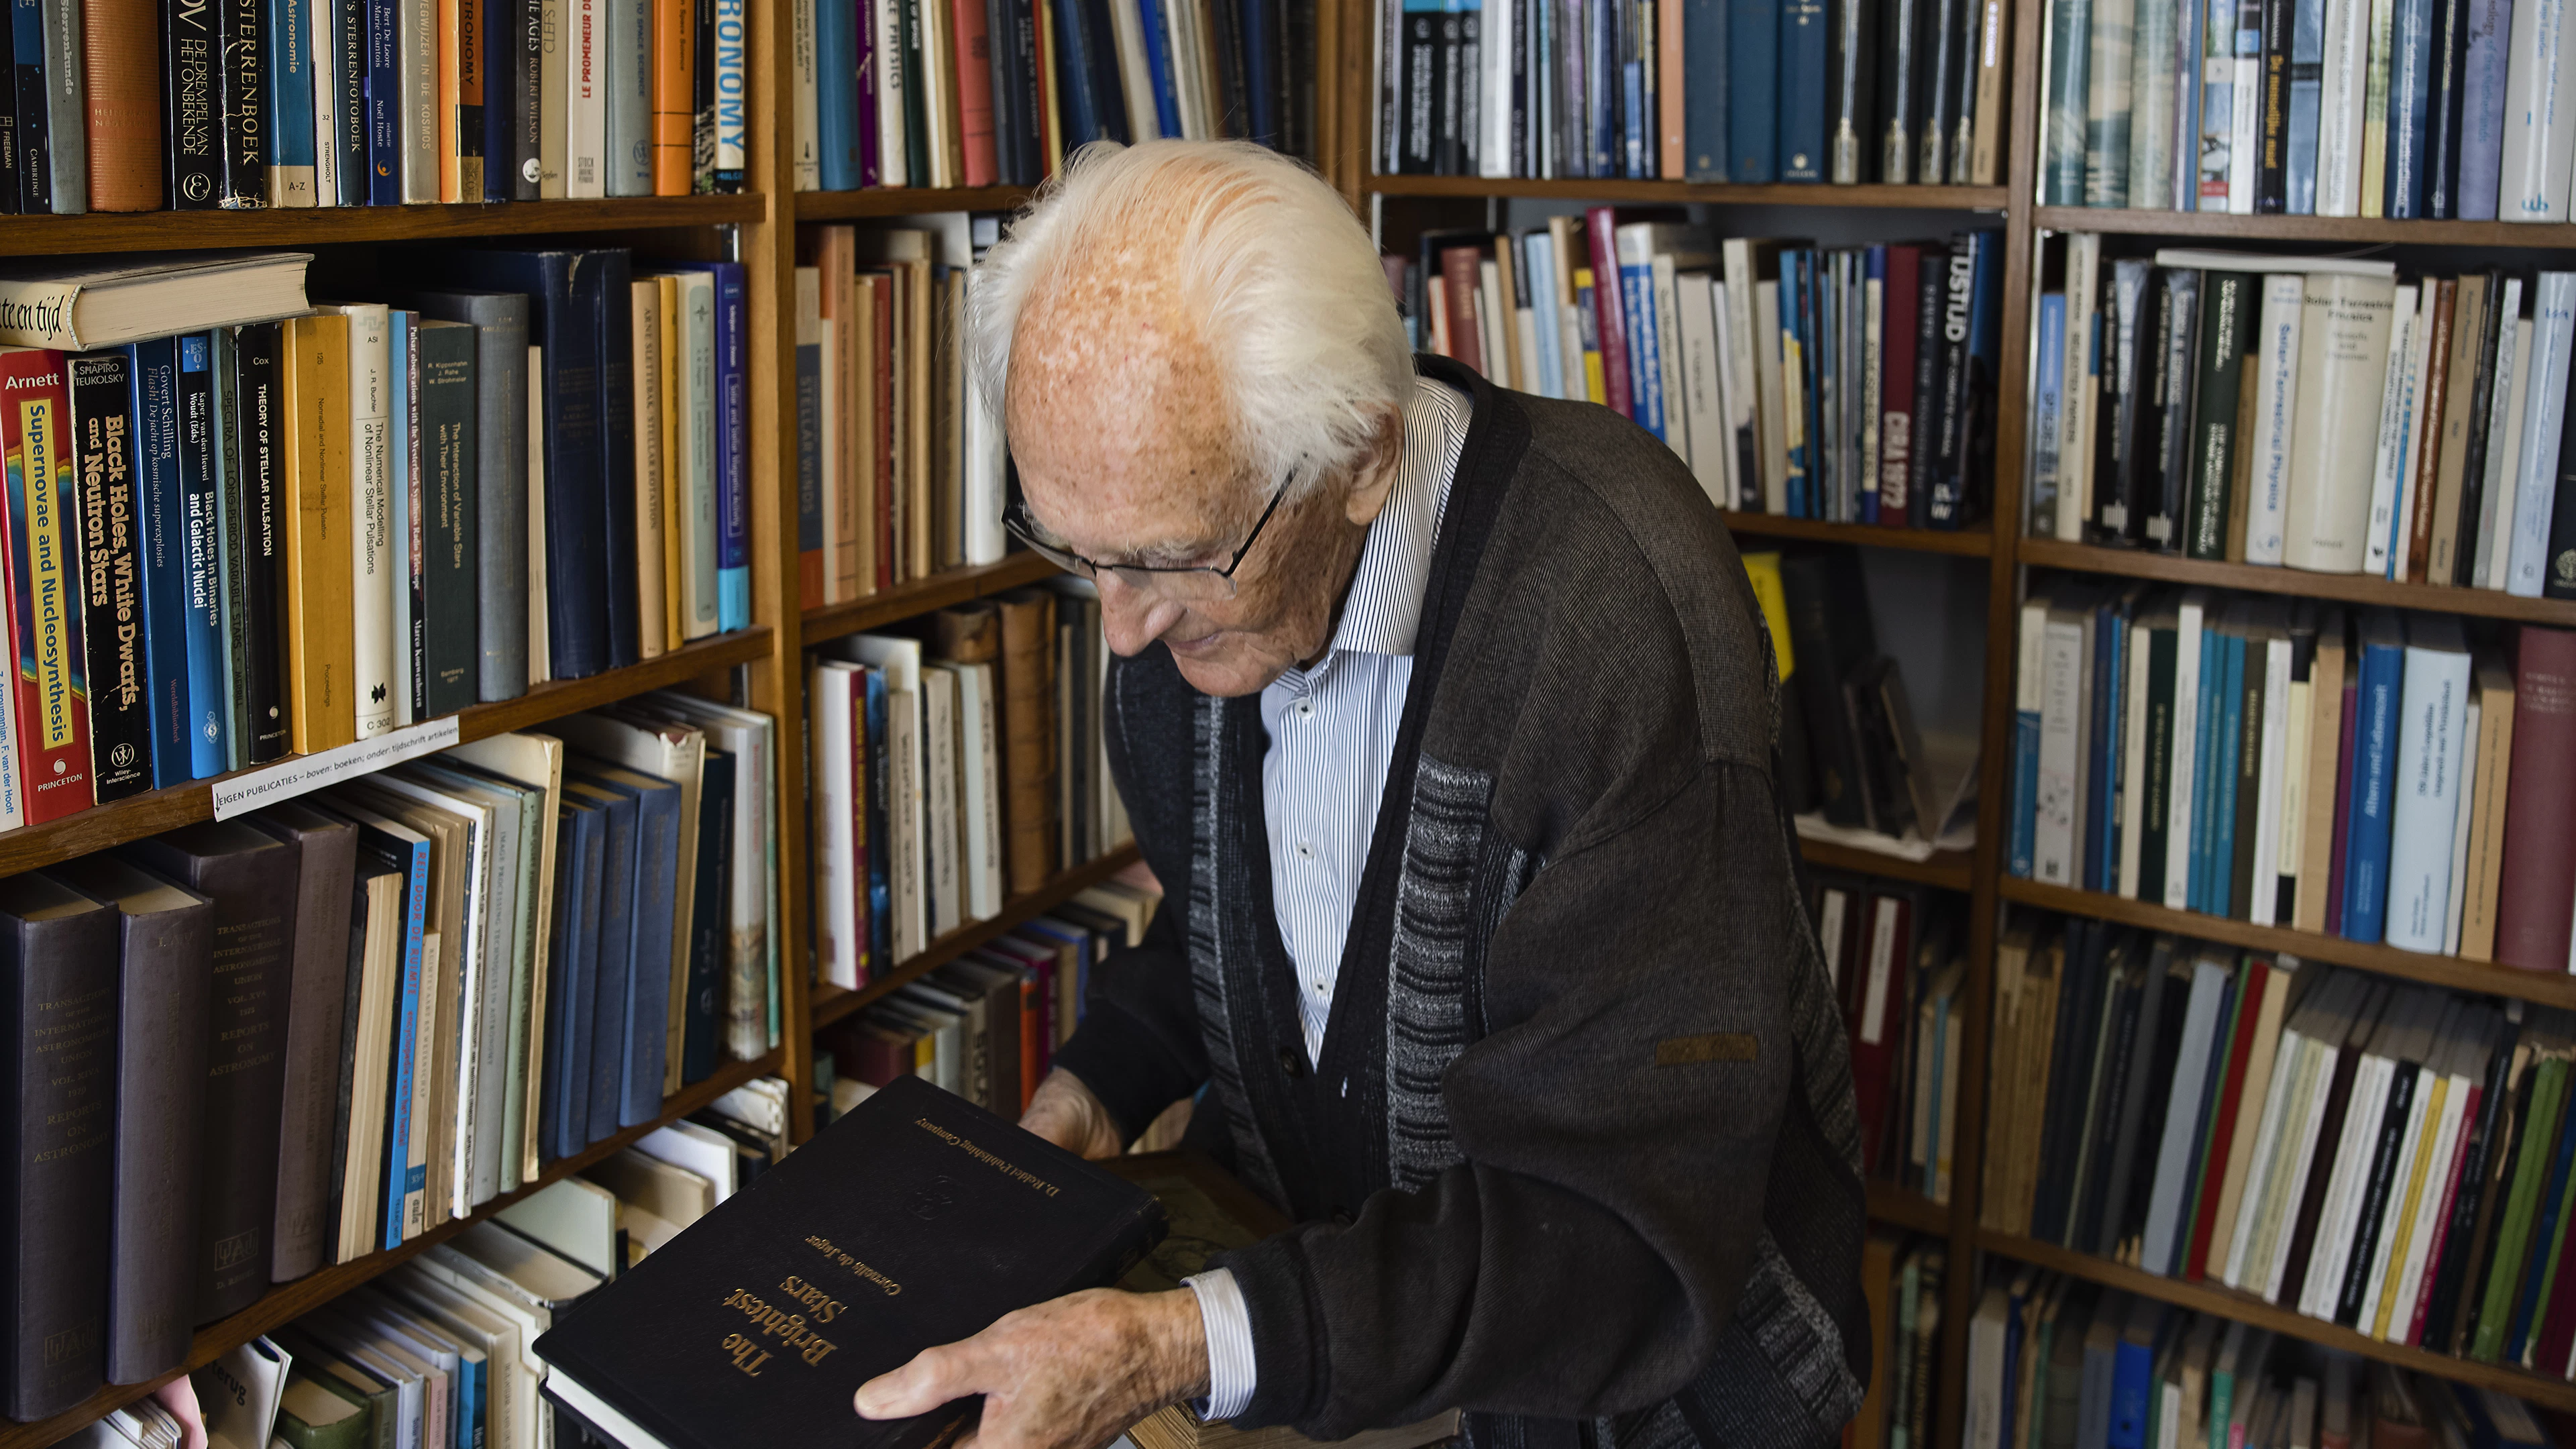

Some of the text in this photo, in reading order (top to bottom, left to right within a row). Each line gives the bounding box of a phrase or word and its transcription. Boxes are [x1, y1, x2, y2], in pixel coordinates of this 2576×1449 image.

[543, 9, 556, 53] CLEFS
[528, 16, 540, 143] AGES ROBERT WILSON
[582, 14, 592, 99] LE PROMENEUR
[888, 25, 901, 89] PHYSICS
[180, 38, 196, 155] HET ONBEKENDE
[195, 40, 209, 156] DE DREMPEL VAN
[347, 16, 361, 153] STERRENFOTOBOEK
[421, 64, 431, 150] IN DE KOSMOS
[3, 131, 11, 168] FREEMAN
[30, 148, 39, 198] CAMBRIDGE
[288, 182, 305, 191] A-Z
[17, 294, 65, 341] en tijd
[5, 373, 59, 390] Arnett
[75, 374, 125, 386] TEUKOLSKY
[79, 363, 119, 375] SHAPIRO
[253, 357, 269, 365] Cox
[160, 365, 174, 460] Govert Schilling
[189, 392, 199, 443] Woudt (Eds.)
[198, 392, 206, 415] Kaper
[410, 326, 420, 487] Pulsar observations Westerbork
[148, 367, 165, 568] Flash! jacht kosmische superexplosies
[201, 451, 209, 481] Heuvel
[258, 384, 272, 557] THEORY OF STELLAR PULSATION
[376, 422, 385, 547] The Numerical Modelling
[439, 445, 449, 528] Their Environment
[85, 417, 110, 606] and Neutron Stars
[223, 390, 242, 649] SPECTRA OF LONG-PERIOD VARIABLE STARS
[364, 437, 376, 575] Nonlinear Stellar Pulsations
[452, 422, 463, 569] The Interaction Variable Stars
[28, 405, 65, 742] Supernovae and Nucleosynthesis
[105, 415, 140, 712] Black Holes, White Dwarfs,
[189, 493, 207, 609] and Galactic Nuclei
[205, 491, 219, 627] Black Holes in Binaries
[170, 678, 180, 744] Wereldbibliotheek
[260, 729, 287, 741] PRINCETON
[376, 718, 390, 728] 302
[2, 755, 14, 814] van der Hooft
[38, 773, 83, 792] PRINCETON
[107, 772, 141, 784] Interscience
[217, 727, 458, 807] EIGEN PUBLICATIES boven: boeken; onder: tijdschrift artikelen
[213, 938, 282, 959] INTERNATIONAL
[217, 916, 281, 934] TRANSACTIONS
[407, 851, 427, 996] REIS DOOR DE RUIMTE
[213, 954, 280, 973] ASTRONOMICAL
[234, 973, 263, 985] UNION
[34, 1010, 112, 1037] INTERNATIONAL
[38, 987, 110, 1011] TRANSACTIONS
[36, 1027, 110, 1053] ASTRONOMICAL
[221, 1022, 269, 1040] REPORTS
[61, 1049, 93, 1064] UNION
[209, 1051, 276, 1077] ASTRONOMY
[47, 1100, 103, 1125] REPORTS
[34, 1130, 109, 1163] ASTRONOMY
[913, 1118, 1062, 1198] D. Reidel Publishing Company
[804, 1236, 902, 1296] Cornelis de Jager
[778, 1276, 849, 1324] Stars
[721, 1288, 839, 1368] Brightest
[722, 1333, 774, 1378] The
